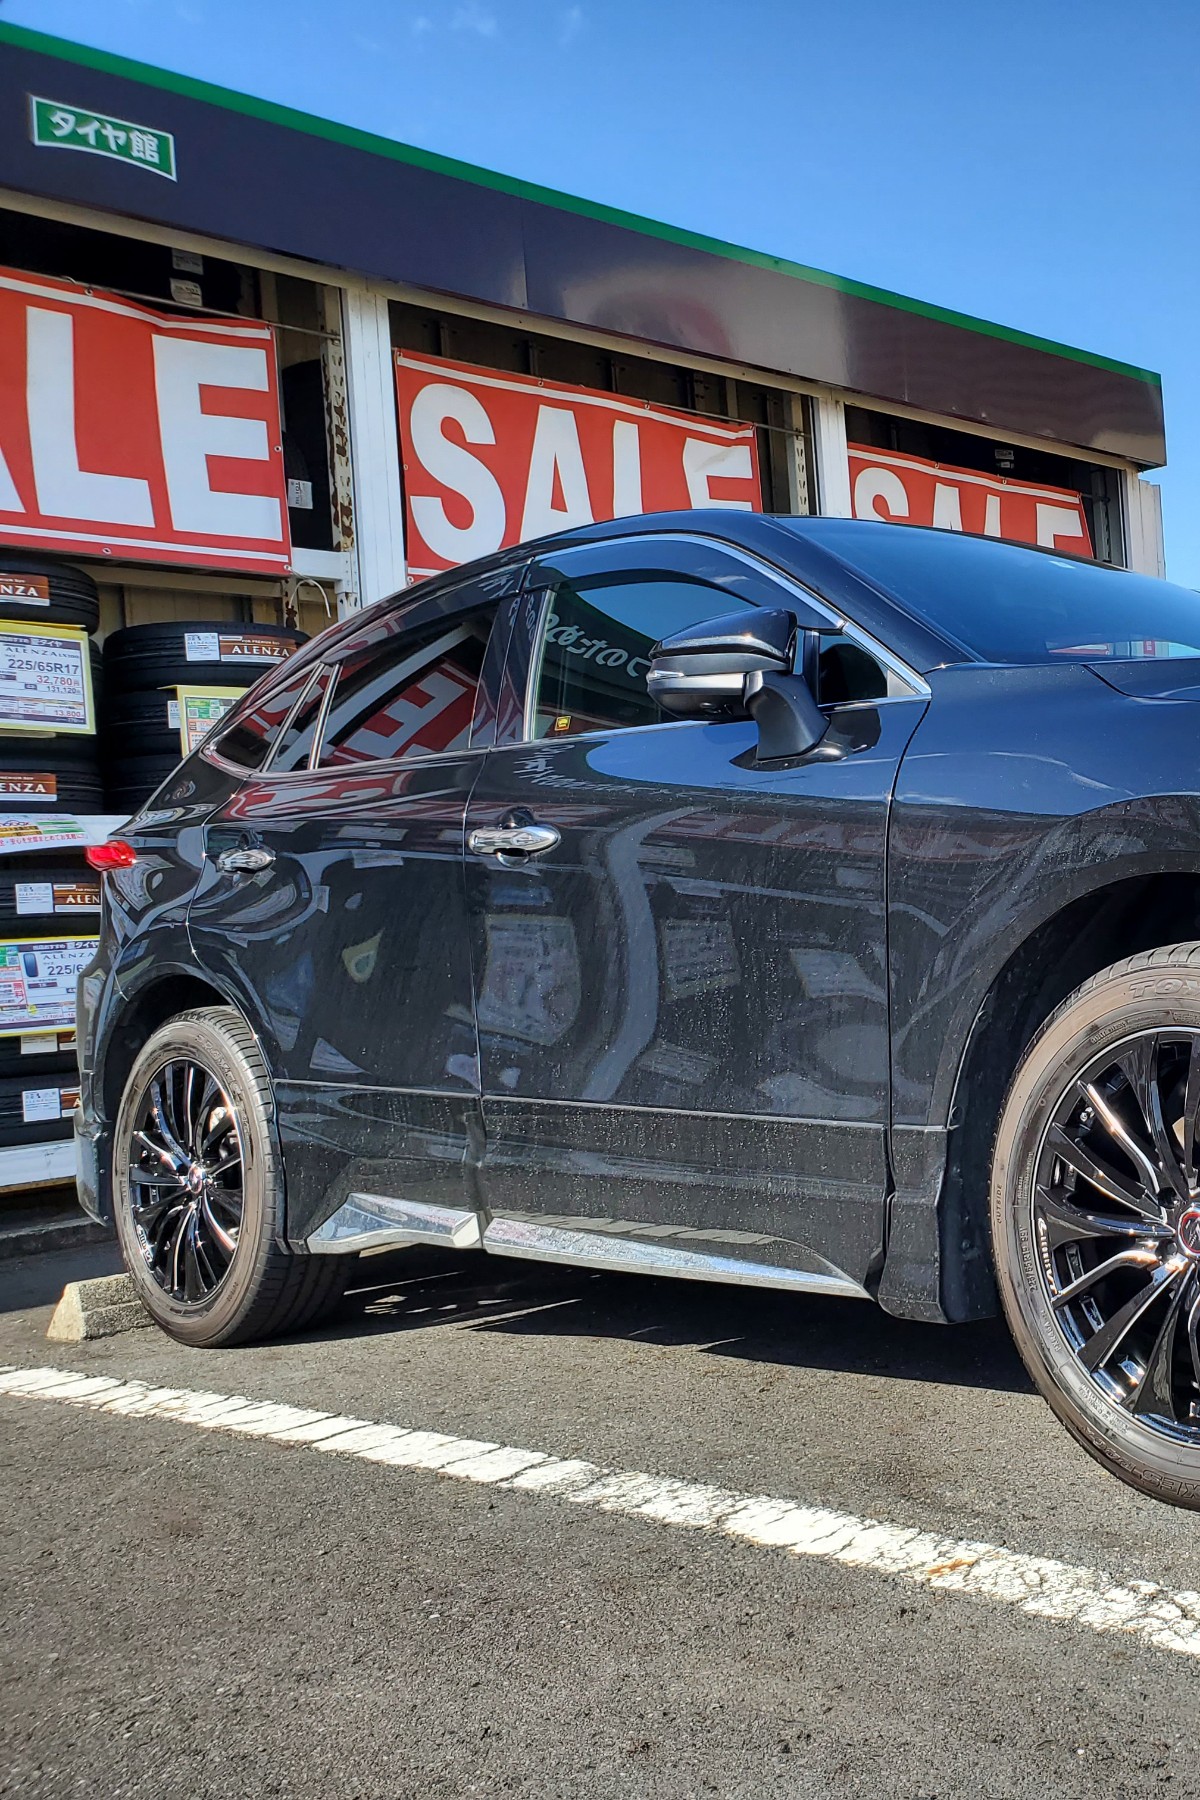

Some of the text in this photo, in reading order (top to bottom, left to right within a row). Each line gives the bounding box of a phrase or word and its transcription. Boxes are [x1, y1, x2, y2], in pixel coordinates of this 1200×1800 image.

[49, 110, 161, 165] タイヤ館
[410, 383, 753, 564] SALE
[8, 659, 79, 675] 225/65R17
[231, 645, 290, 657] ALENZA
